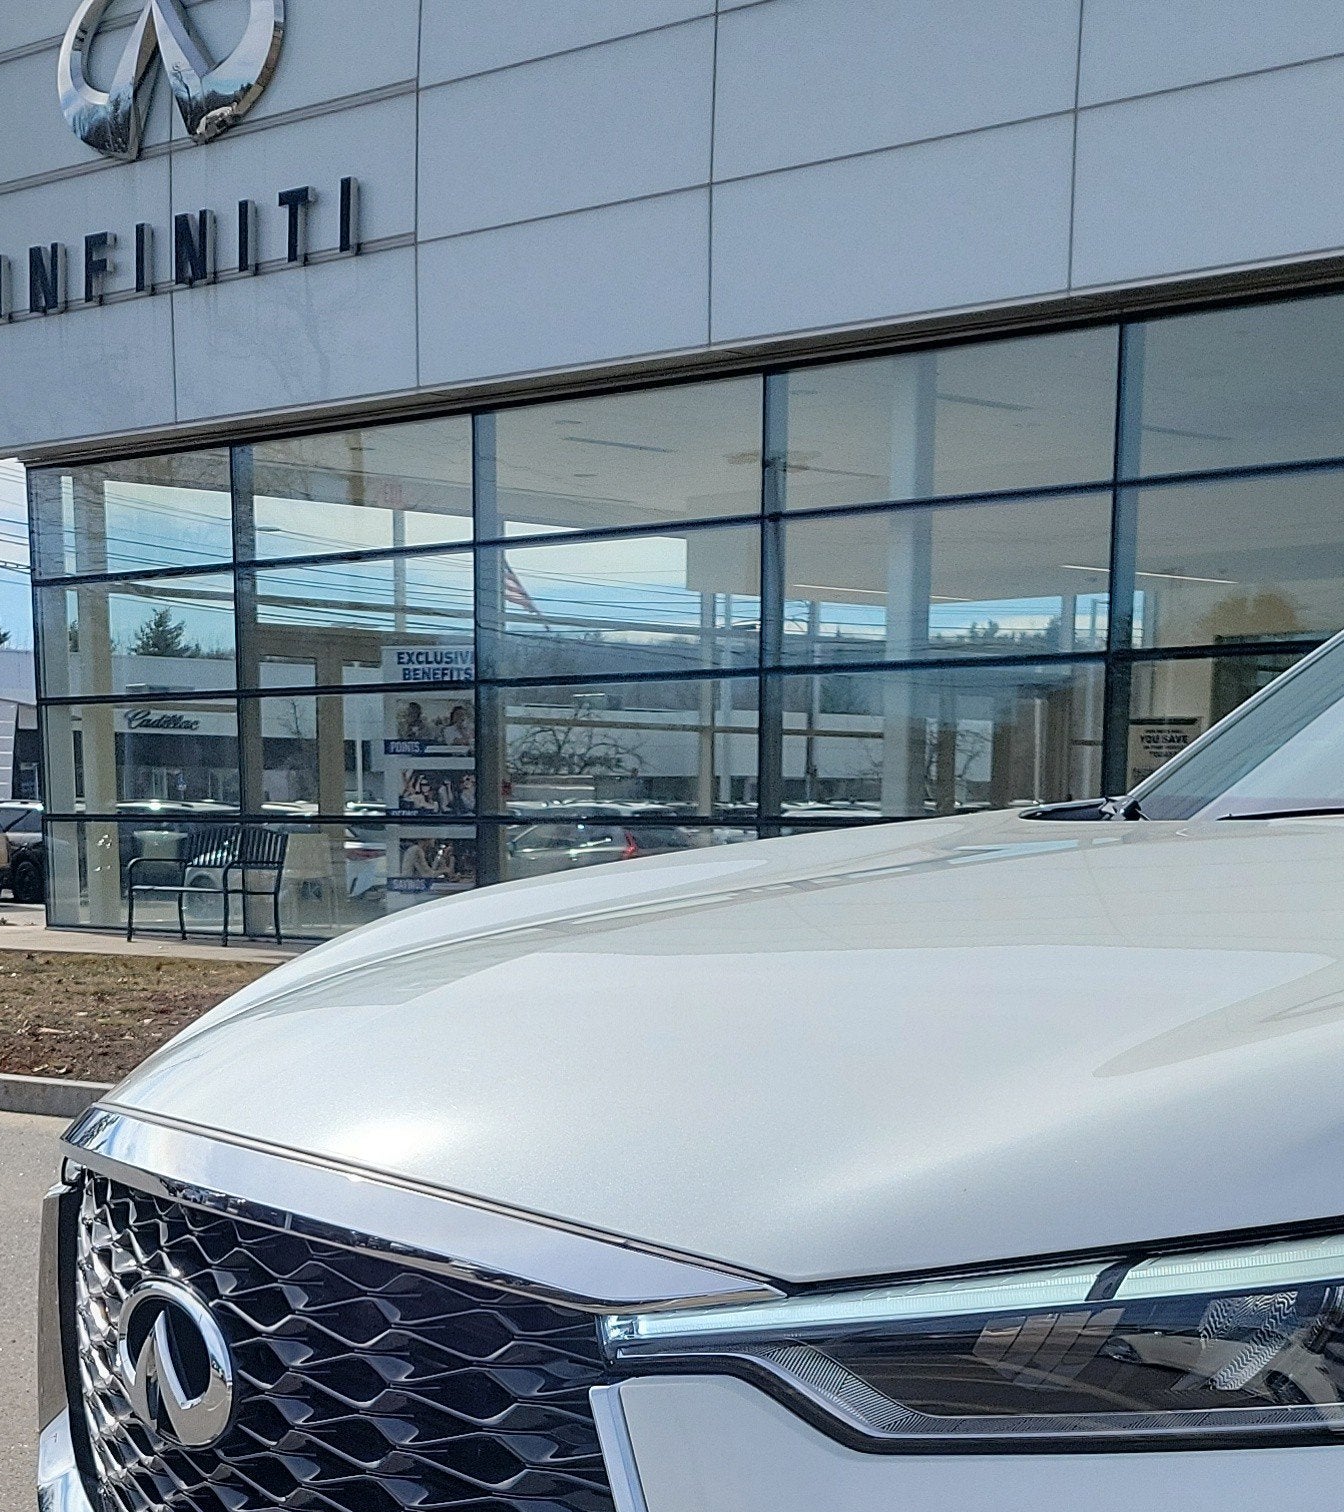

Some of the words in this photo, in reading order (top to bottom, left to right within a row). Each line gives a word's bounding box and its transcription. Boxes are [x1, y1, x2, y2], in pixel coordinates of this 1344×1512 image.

[397, 650, 475, 665] EXCLUSIV
[402, 666, 474, 681] BENEFITS
[124, 708, 200, 731] Cadillac
